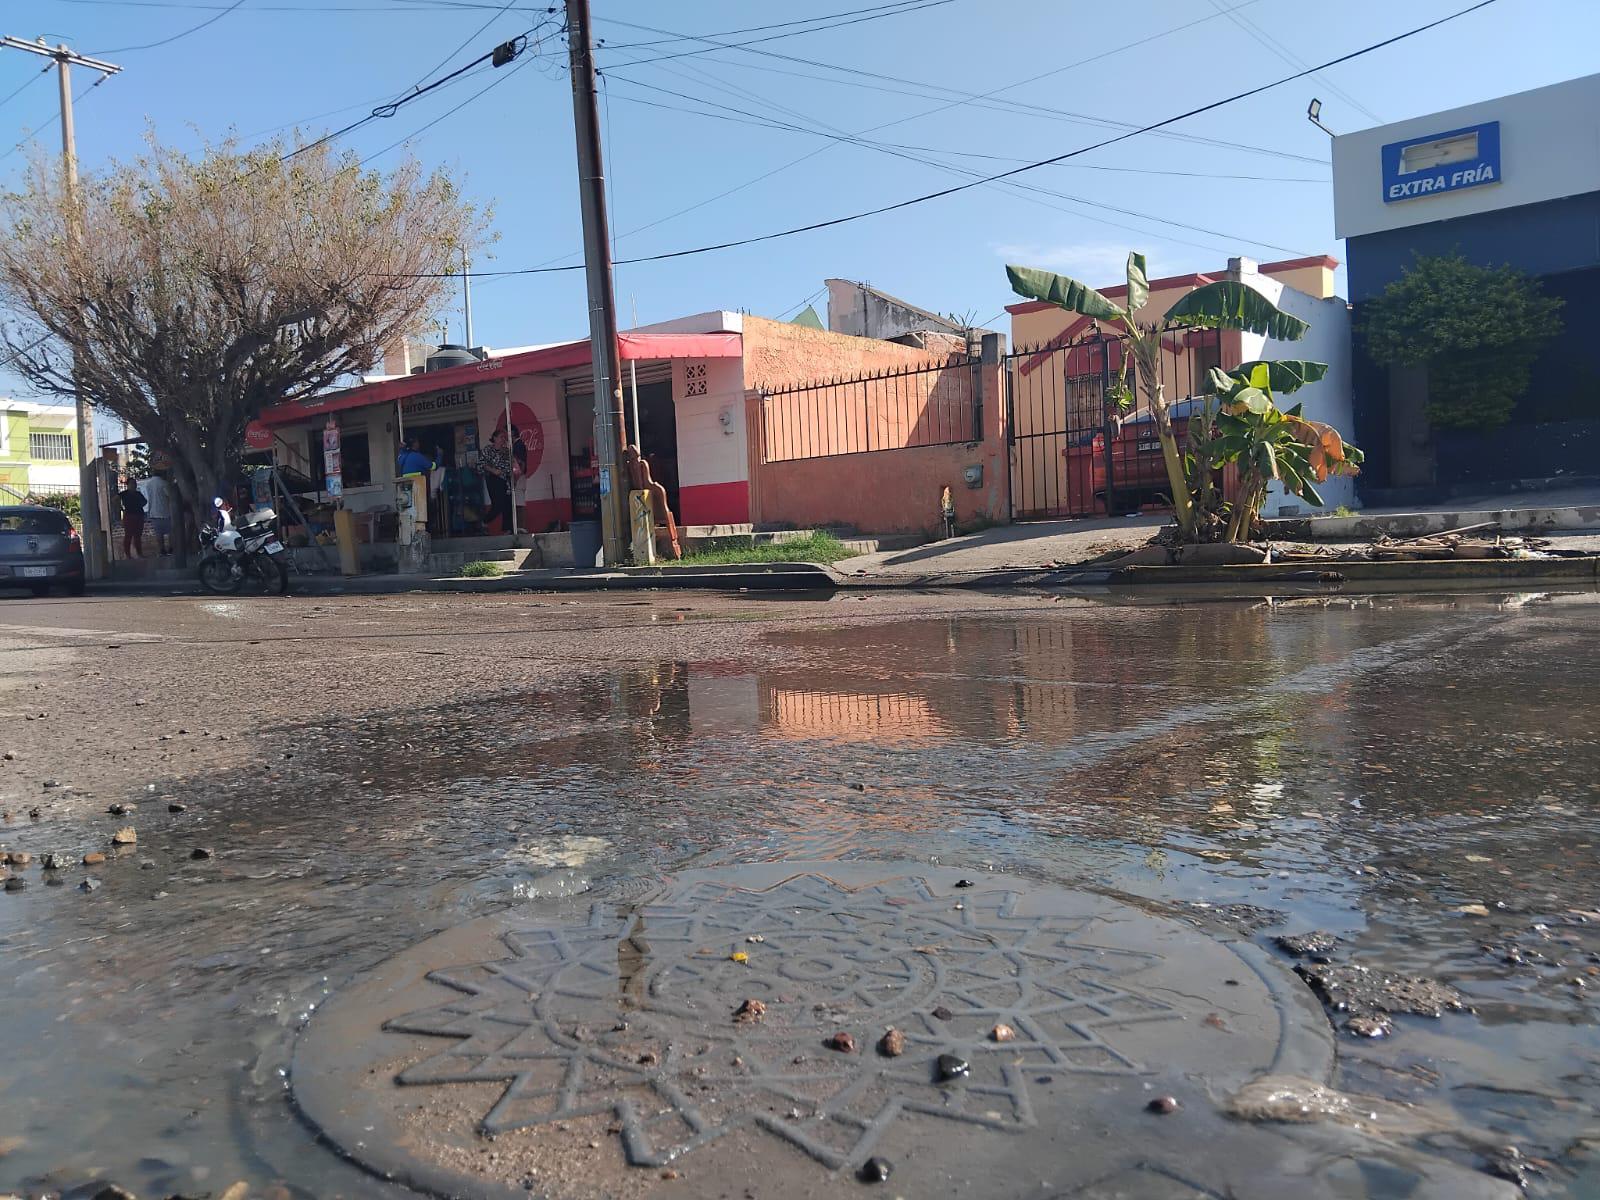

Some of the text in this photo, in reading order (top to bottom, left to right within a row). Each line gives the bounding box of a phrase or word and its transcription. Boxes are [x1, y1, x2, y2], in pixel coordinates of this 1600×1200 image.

[1389, 162, 1494, 198] EXTRA FRÍA
[436, 390, 475, 409] GISELLE
